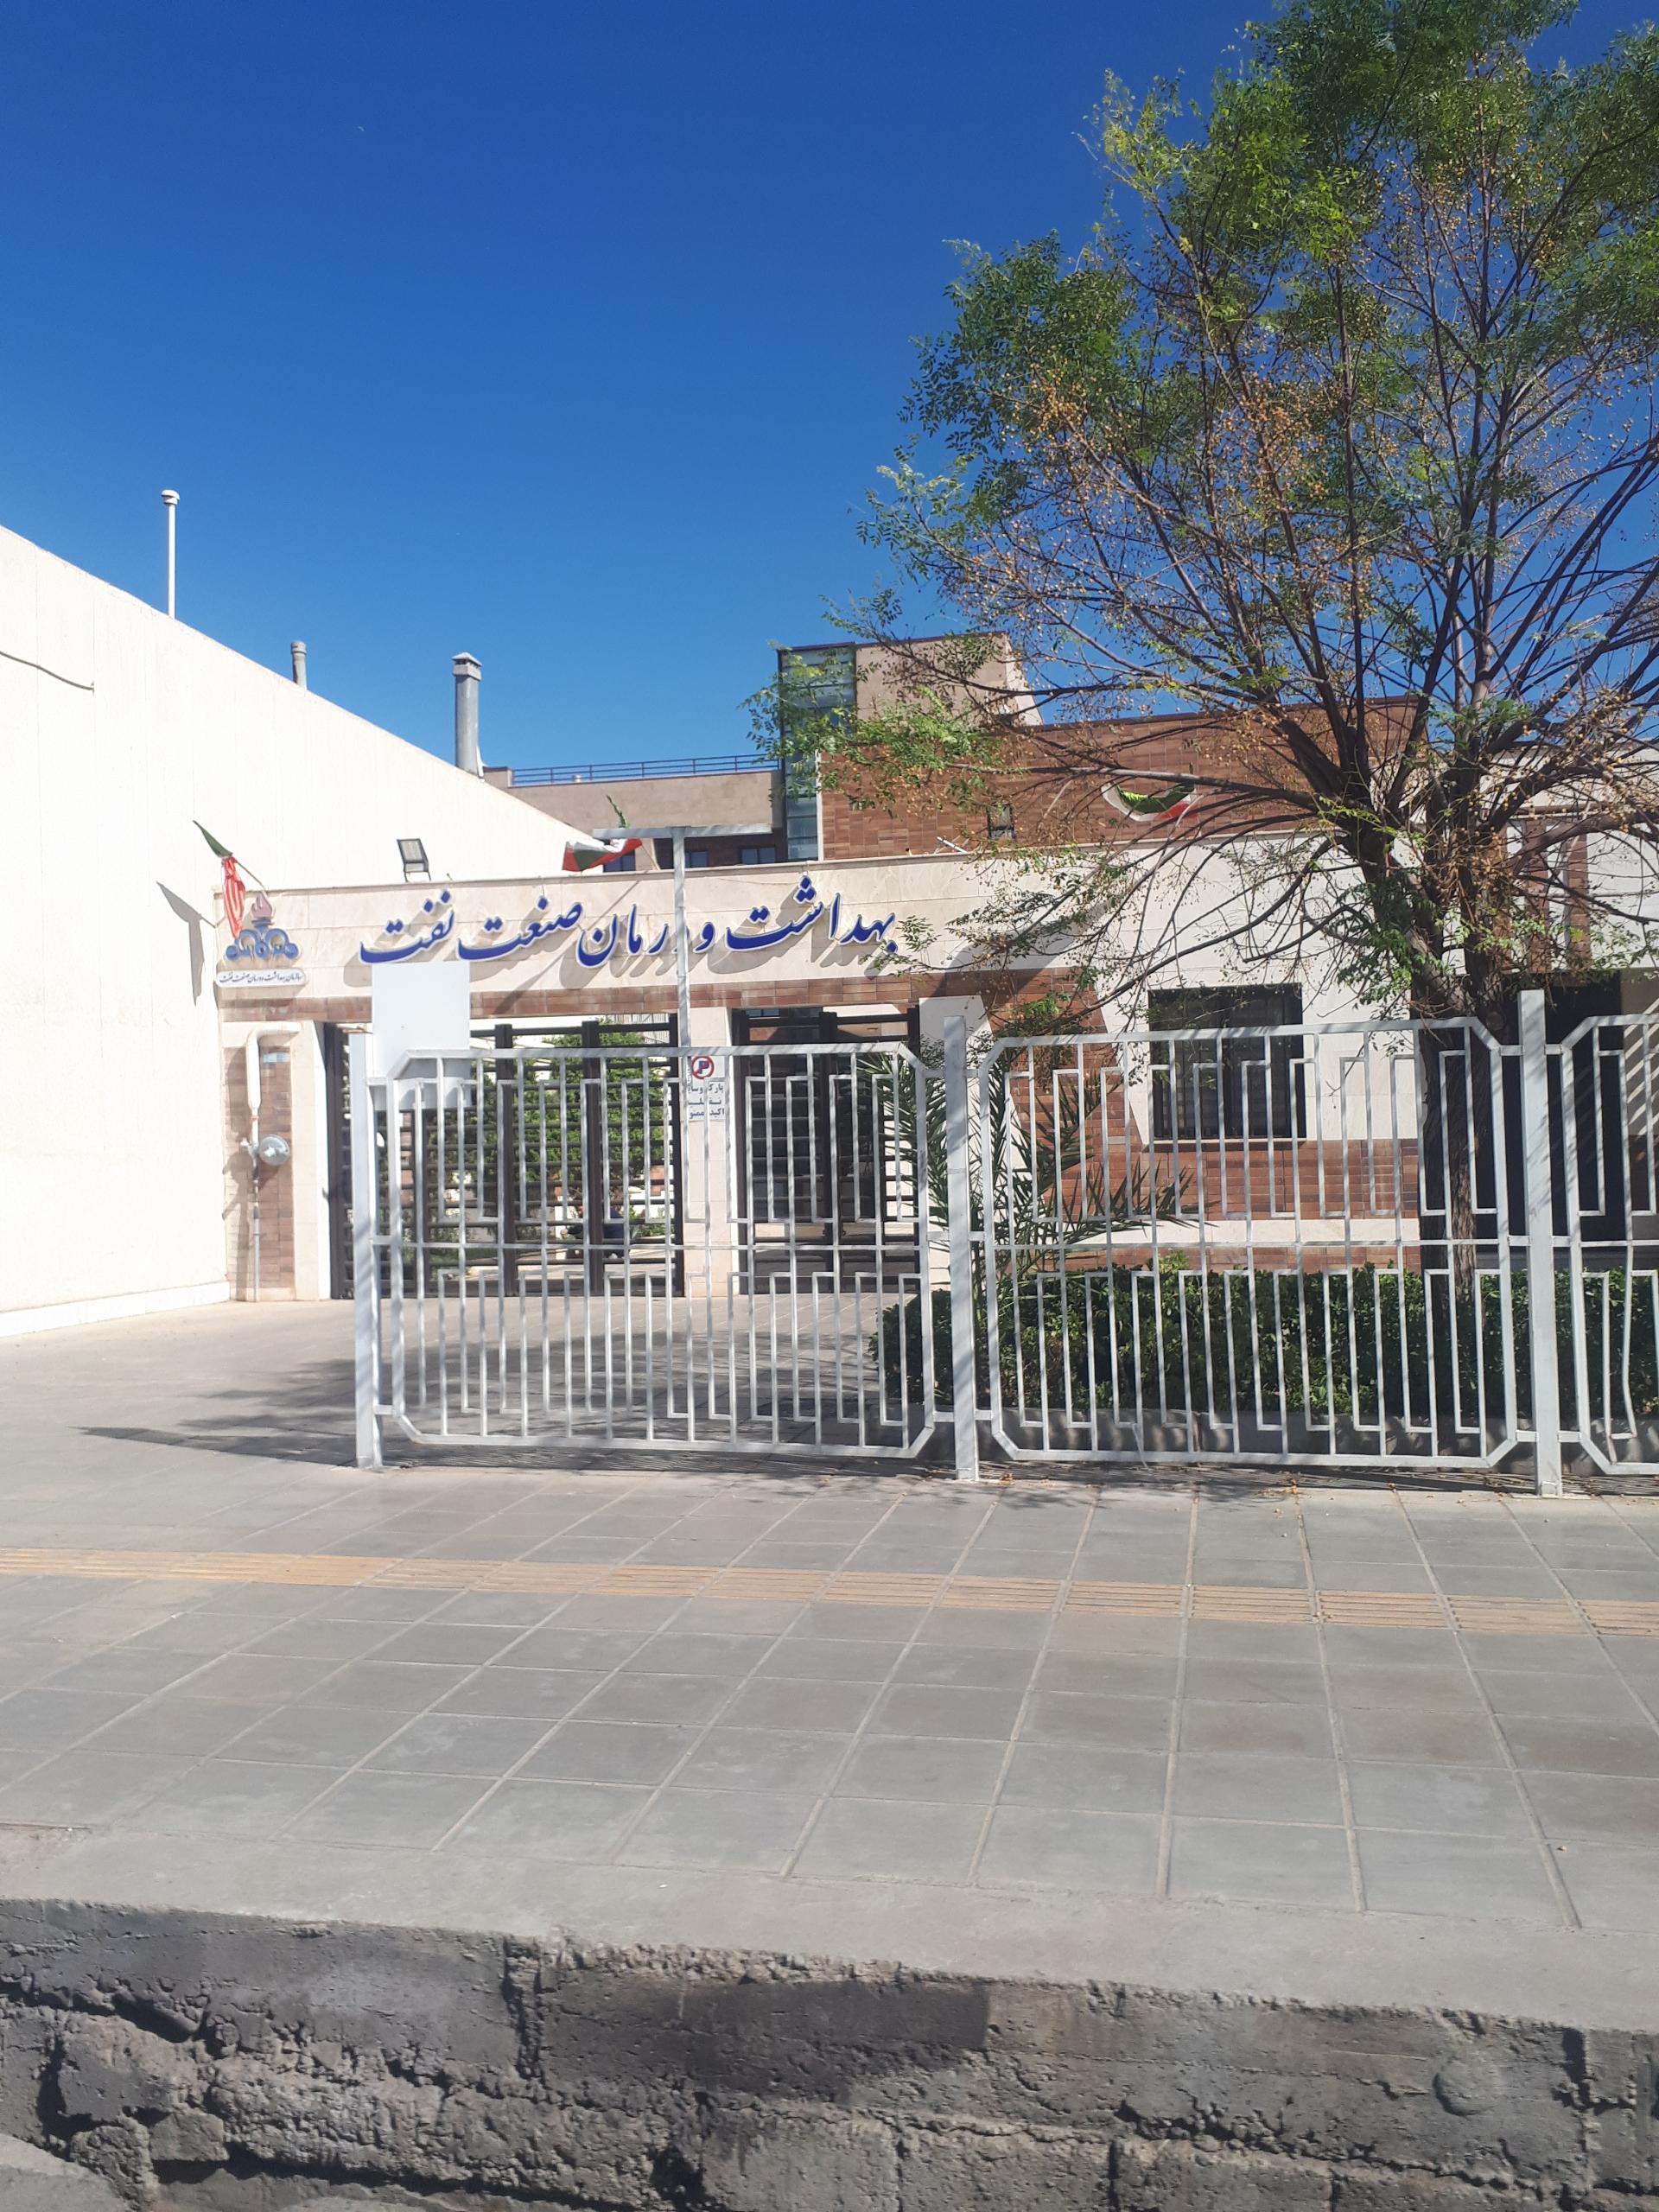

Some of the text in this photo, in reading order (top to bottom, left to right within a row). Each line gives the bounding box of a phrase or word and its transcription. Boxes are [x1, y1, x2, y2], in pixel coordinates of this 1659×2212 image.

[359, 889, 455, 964] نفت
[456, 895, 584, 962] صنعت
[692, 920, 716, 954] و
[725, 874, 899, 954] بهداشت
[688, 1084, 703, 1094] وسای
[689, 1109, 705, 1120] ممنو
